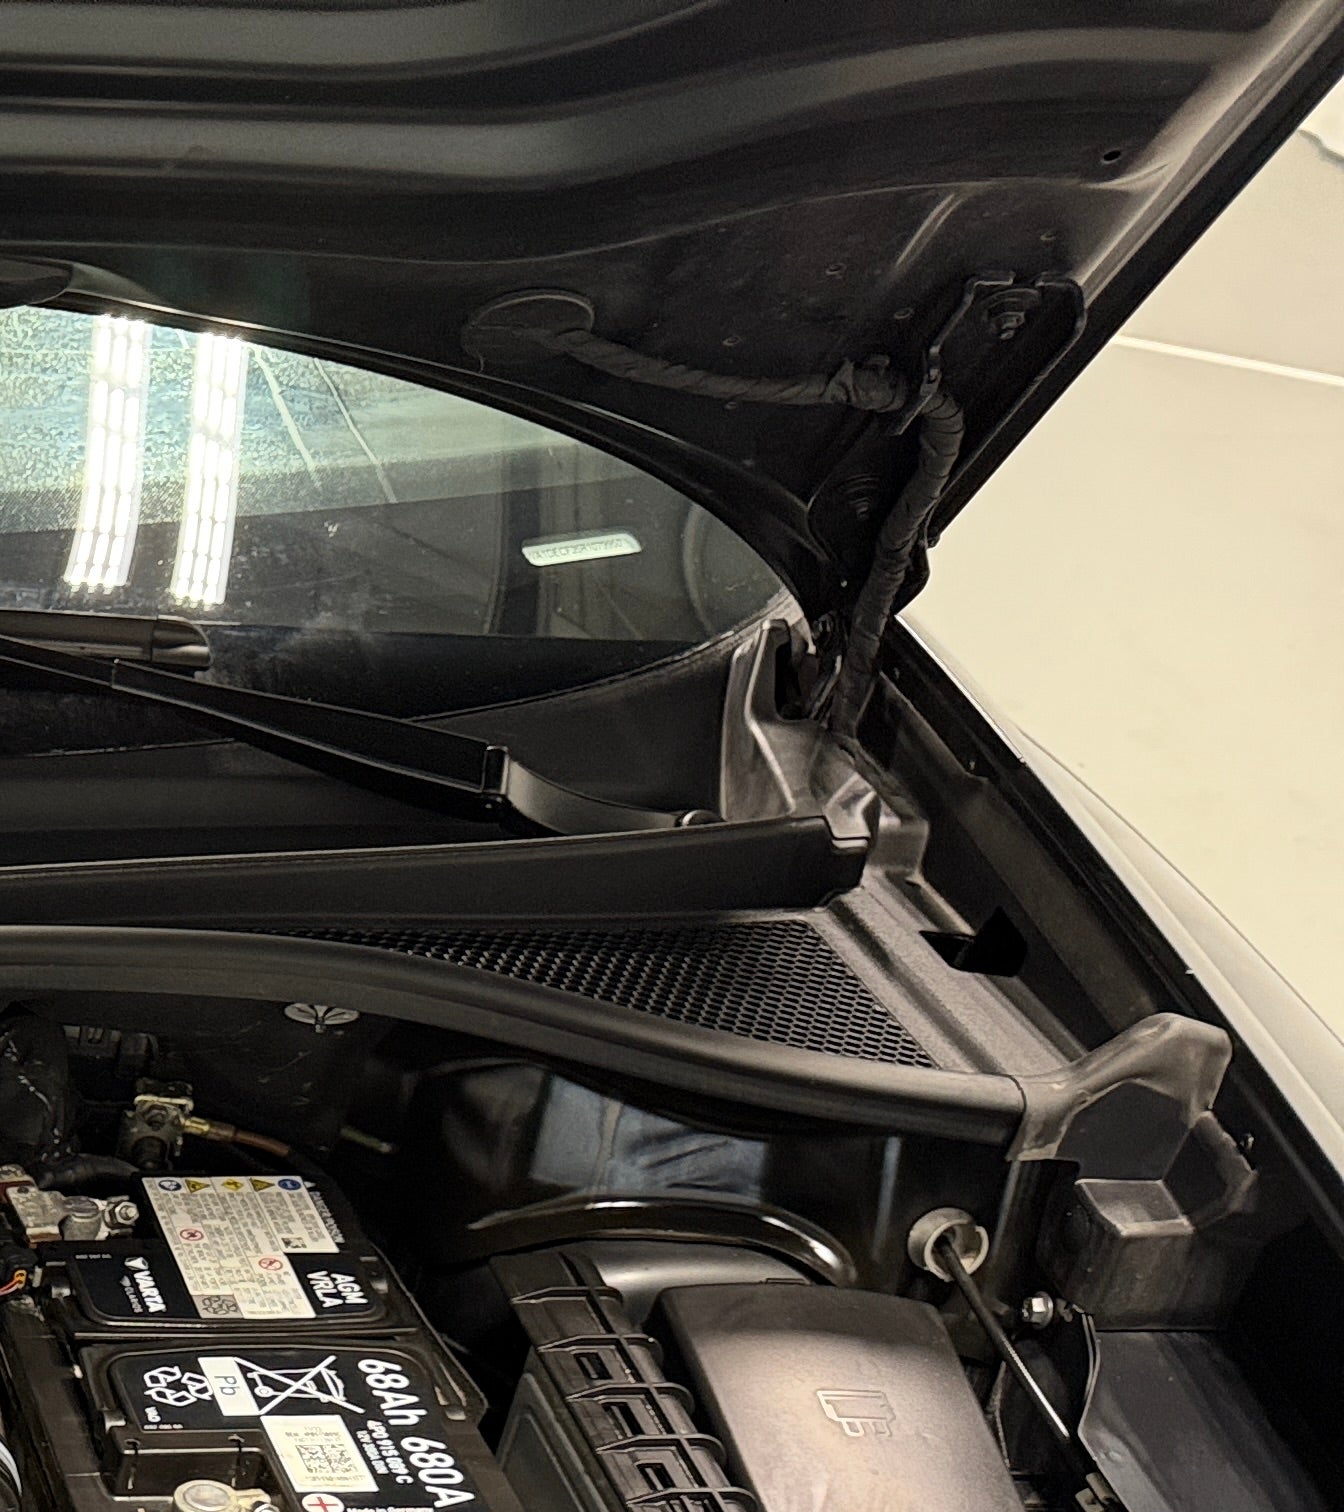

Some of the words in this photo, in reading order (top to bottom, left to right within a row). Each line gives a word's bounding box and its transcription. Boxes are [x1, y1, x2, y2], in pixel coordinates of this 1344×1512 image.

[133, 1270, 167, 1313] VARTA
[306, 1270, 344, 1308] VRLA
[330, 1273, 369, 1304] AGM
[214, 1375, 240, 1396] Pb
[357, 1358, 428, 1426] 68Ah
[400, 1436, 476, 1509] 680A
